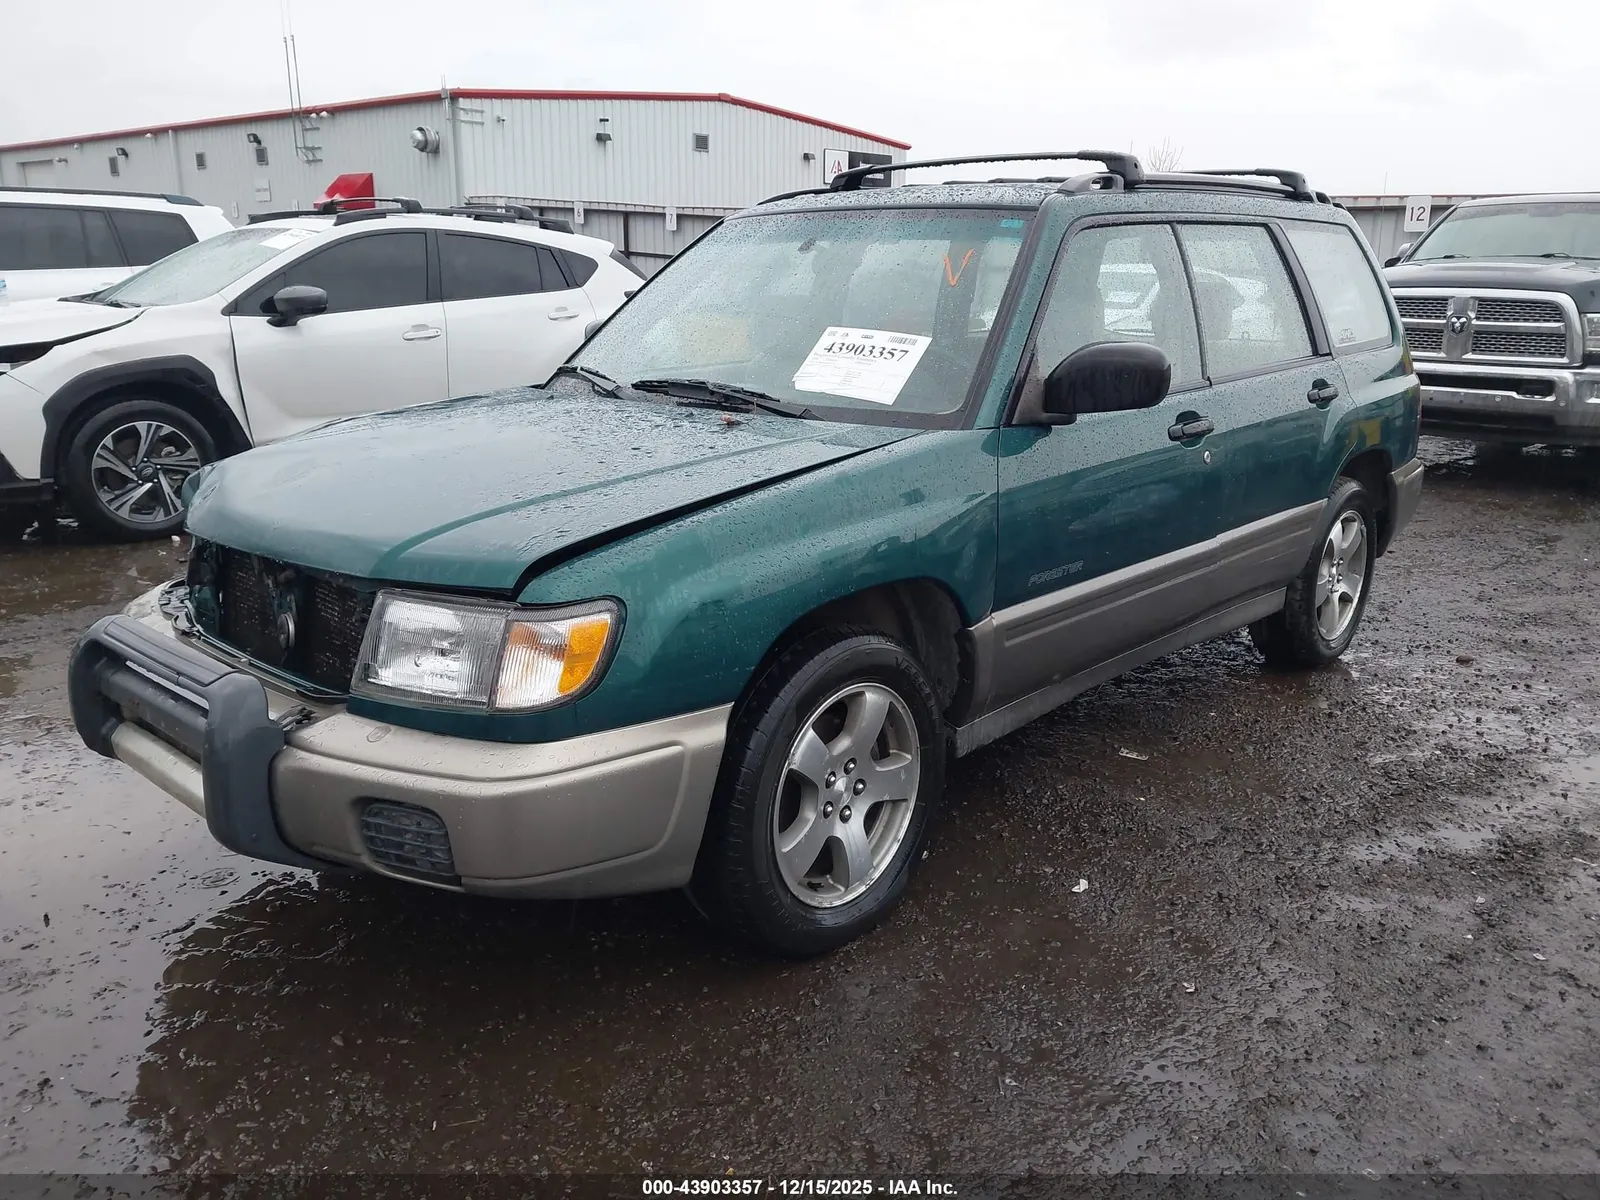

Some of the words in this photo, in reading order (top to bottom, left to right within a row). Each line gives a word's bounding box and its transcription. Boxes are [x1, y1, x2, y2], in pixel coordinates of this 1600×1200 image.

[576, 208, 582, 217] 6
[668, 213, 674, 224] 7
[1409, 206, 1426, 222] 12
[824, 341, 909, 362] 43903357
[1028, 560, 1084, 587] FORESTER
